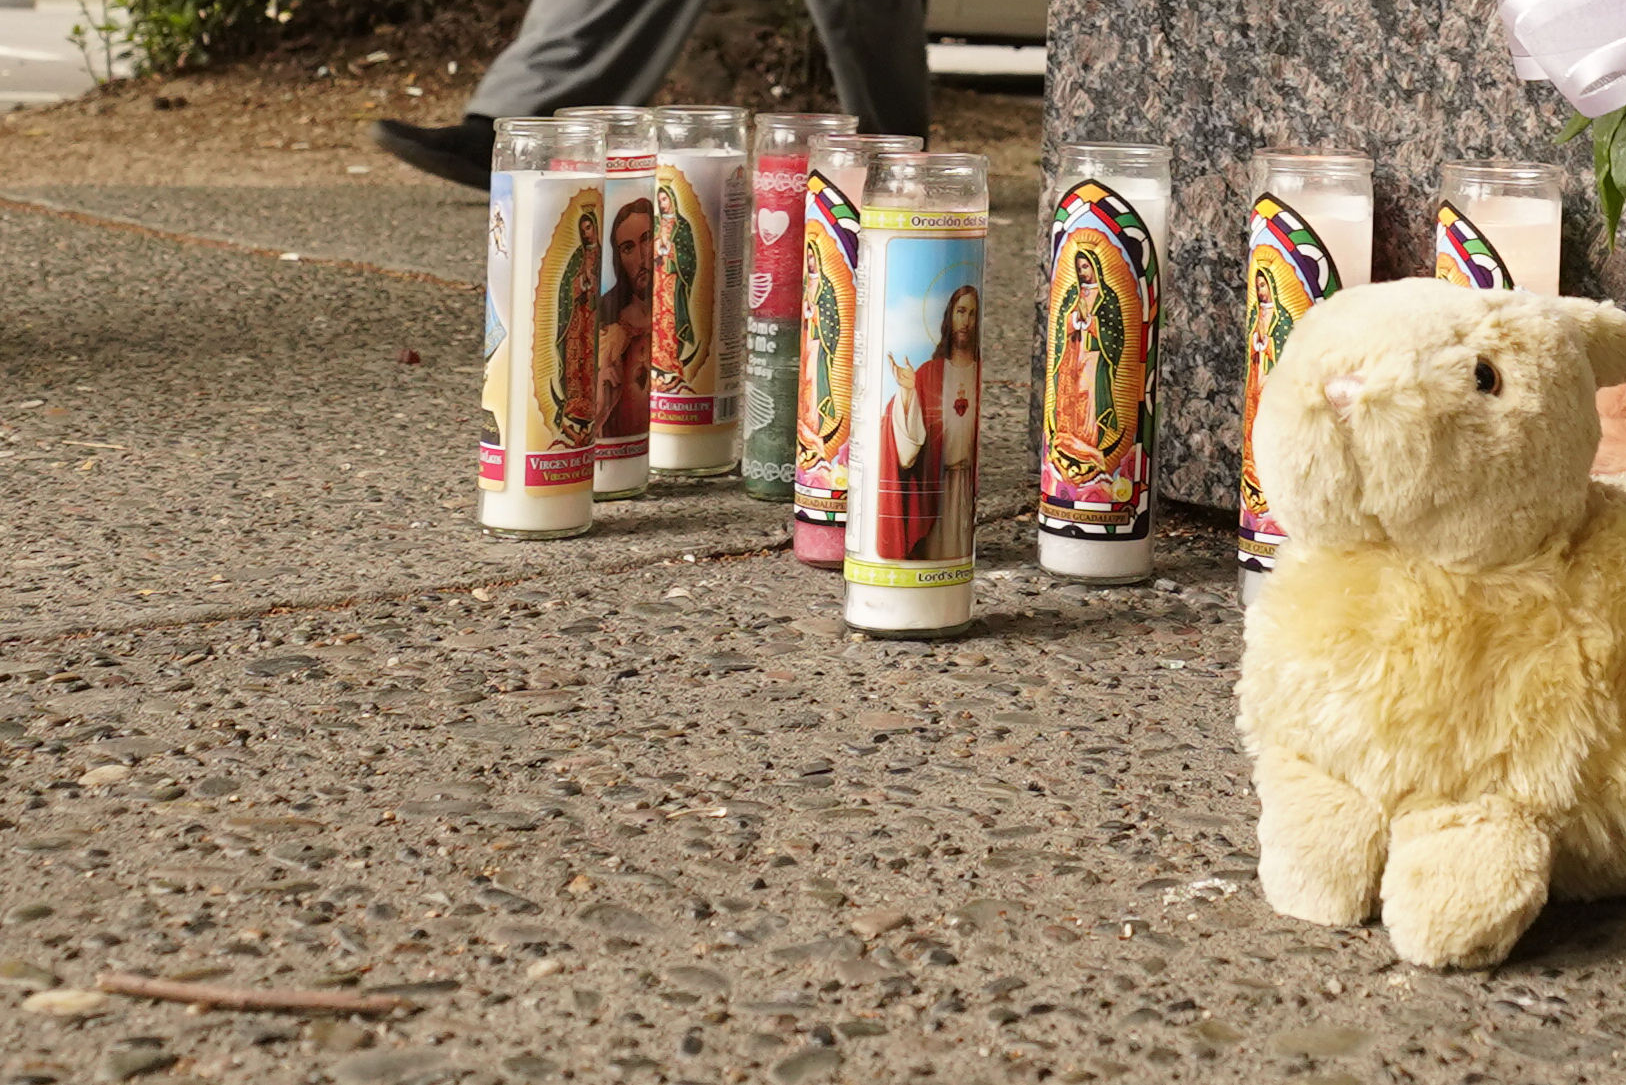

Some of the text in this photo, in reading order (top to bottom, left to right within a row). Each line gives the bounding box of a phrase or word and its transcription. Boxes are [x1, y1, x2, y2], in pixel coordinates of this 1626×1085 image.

[911, 215, 961, 227] Oración
[658, 399, 711, 412] GUADALUPE
[530, 457, 568, 470] VIRGEN
[570, 457, 582, 467] DE
[1073, 512, 1127, 524] GUADALUPE
[918, 571, 953, 582] Lord's
